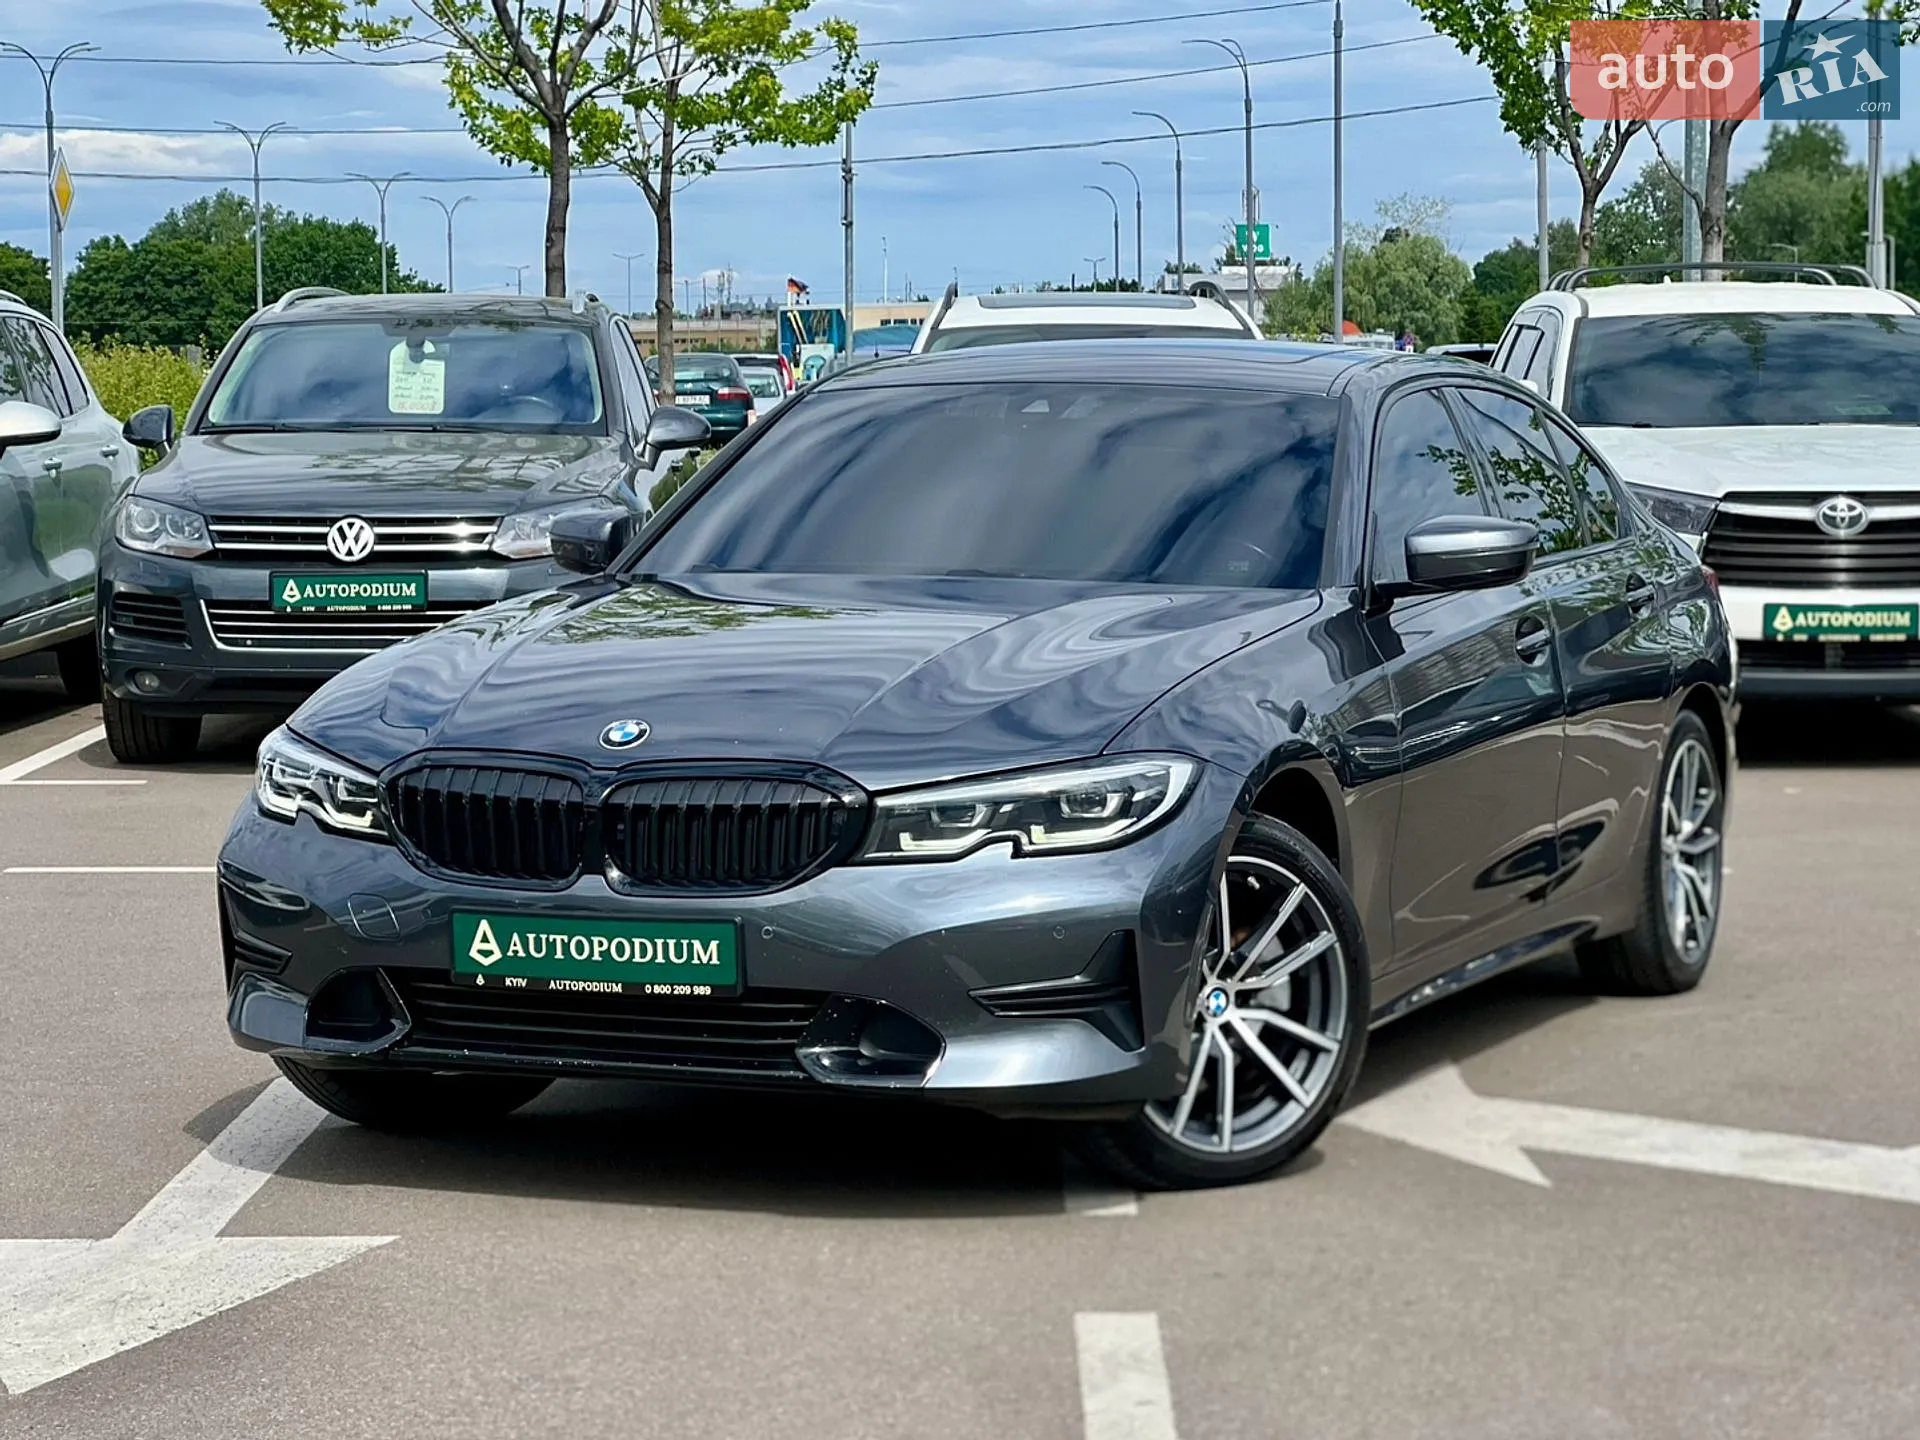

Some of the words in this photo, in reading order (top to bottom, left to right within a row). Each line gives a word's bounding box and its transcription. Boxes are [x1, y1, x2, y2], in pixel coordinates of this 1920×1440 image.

[303, 583, 417, 598] AUTOPODIUM
[1794, 611, 1911, 627] AUTOPODIUM
[507, 932, 720, 965] AUTOPODIUM
[505, 976, 527, 988] KYIV
[548, 979, 622, 993] AUTOPODIUM
[645, 984, 652, 994] 0
[653, 984, 672, 994] 800
[673, 985, 692, 995] 209
